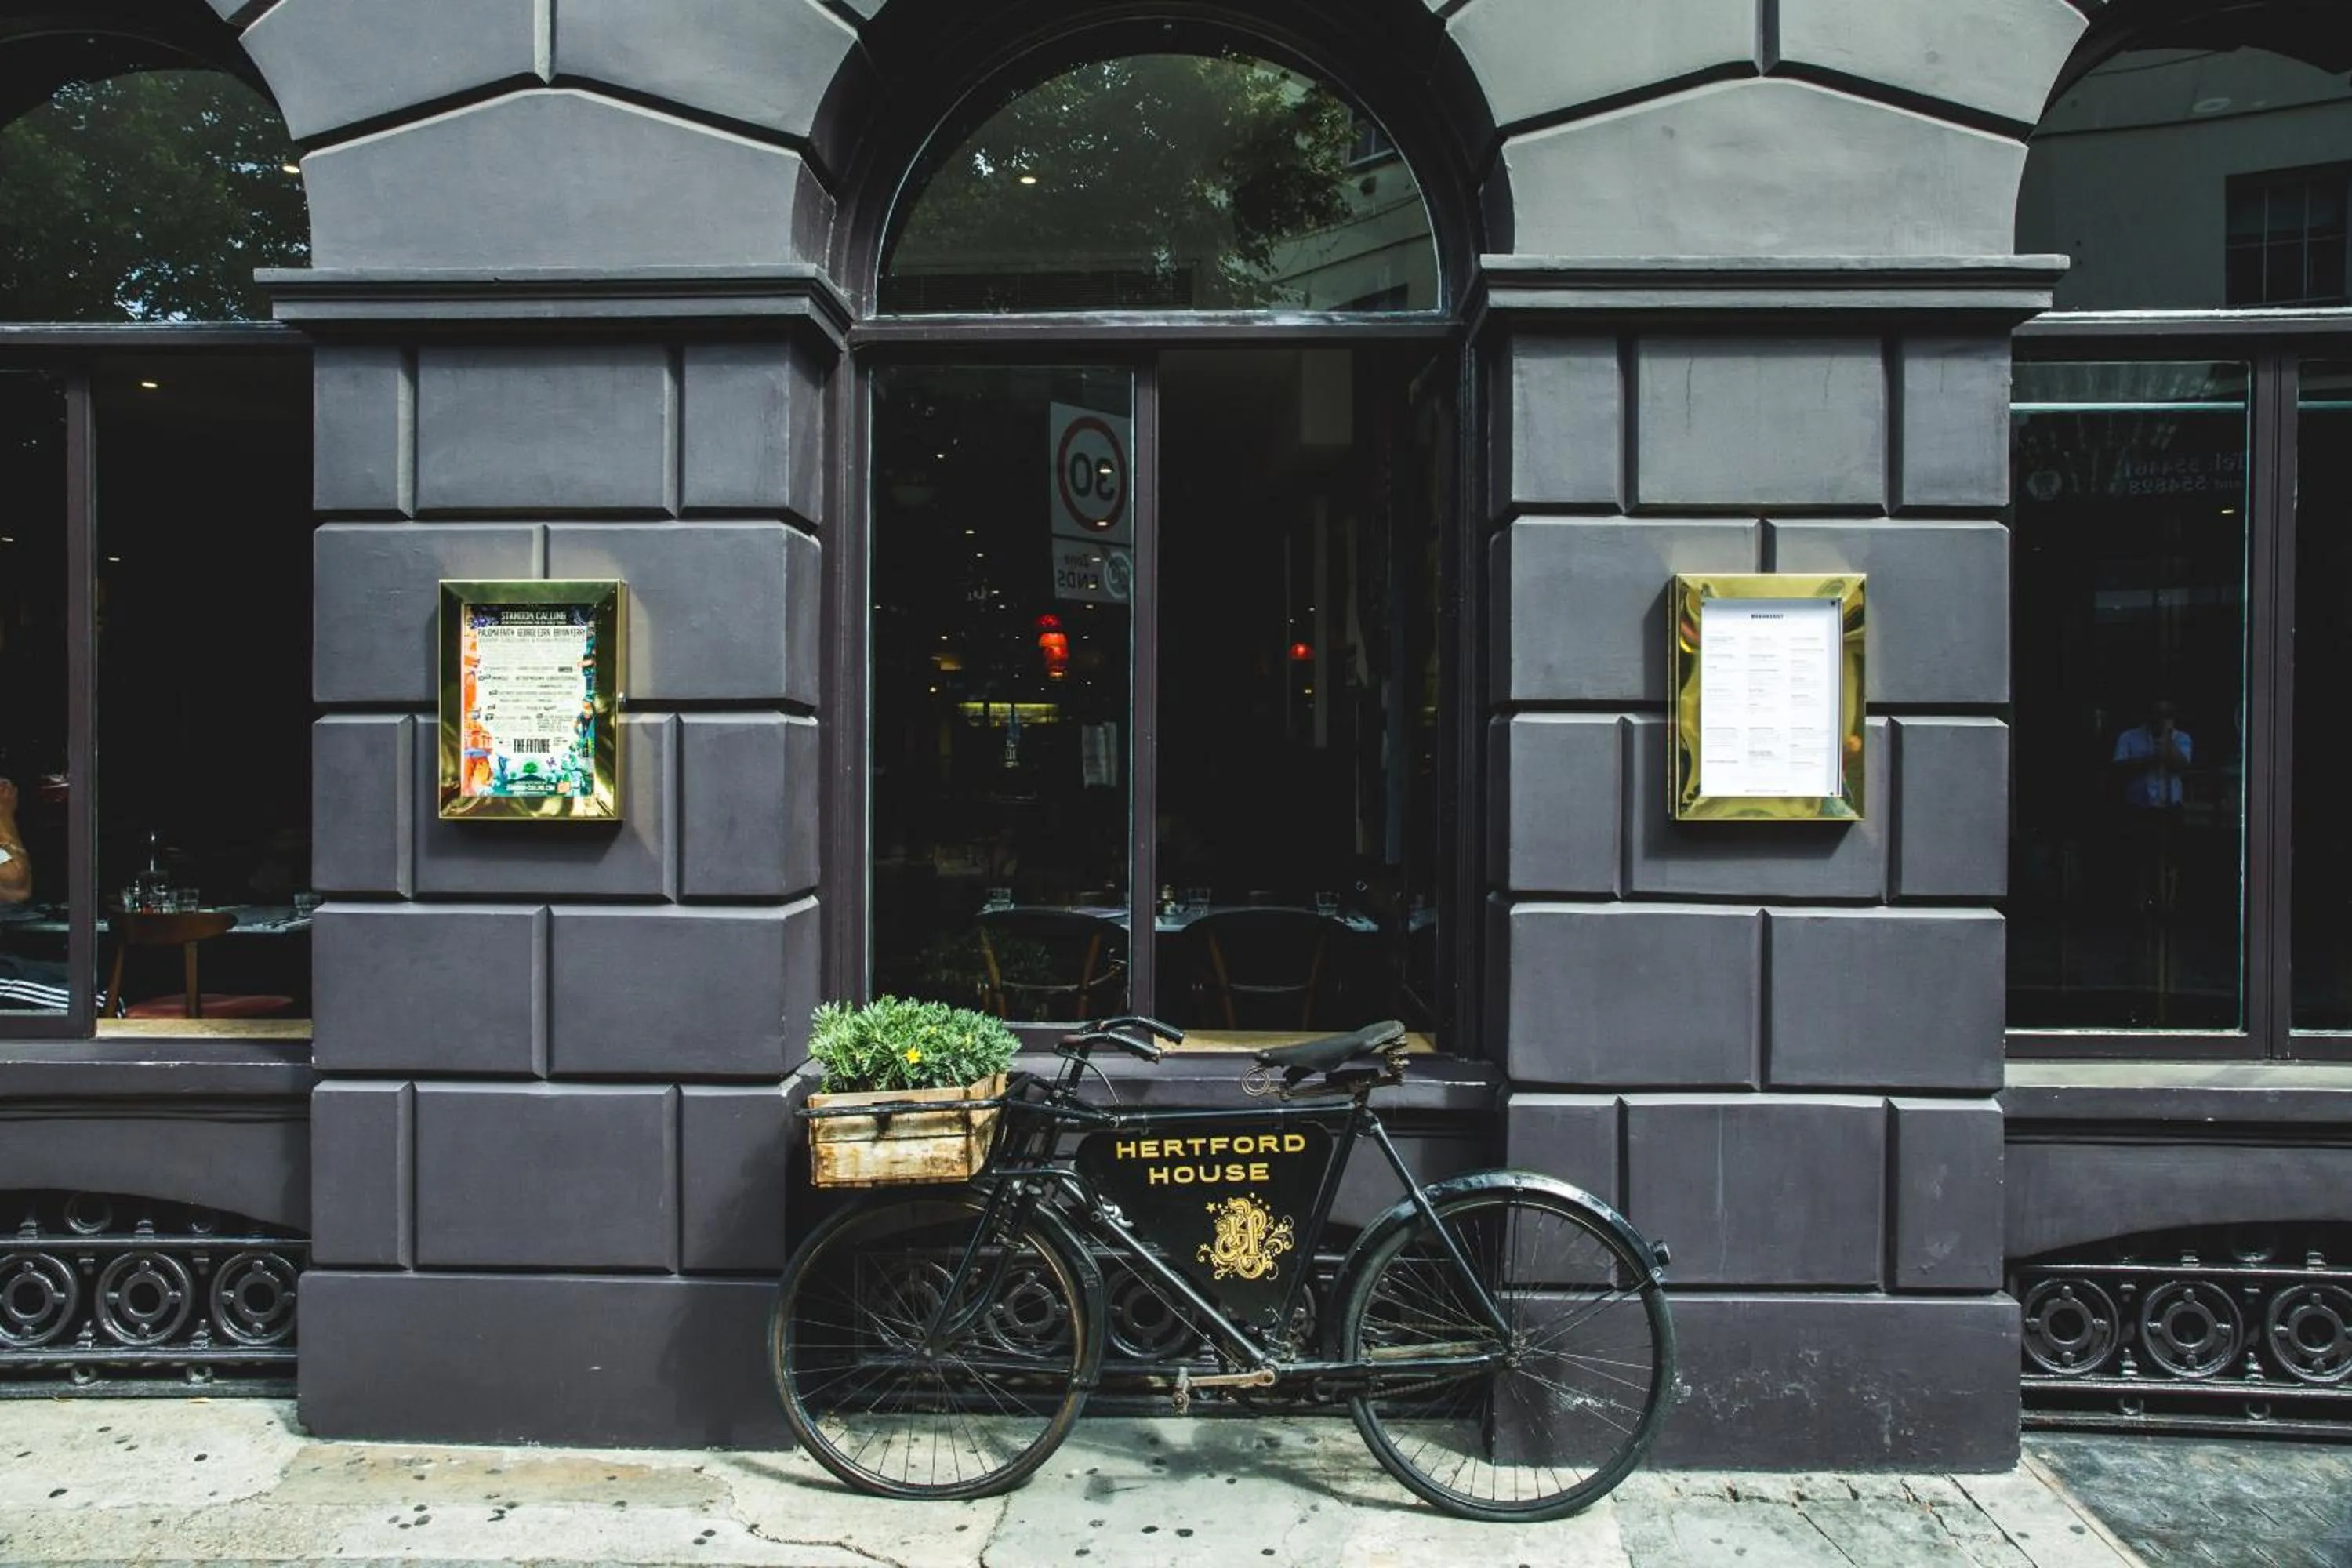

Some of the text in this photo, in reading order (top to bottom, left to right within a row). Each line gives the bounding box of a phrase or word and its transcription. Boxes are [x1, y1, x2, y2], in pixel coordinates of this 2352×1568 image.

[501, 611, 567, 620] STANDON CALLING
[514, 739, 524, 753] THE
[526, 739, 550, 753] FUTURE
[1116, 1134, 1305, 1160] HERTFORD
[1149, 1163, 1270, 1185] HOUSE
